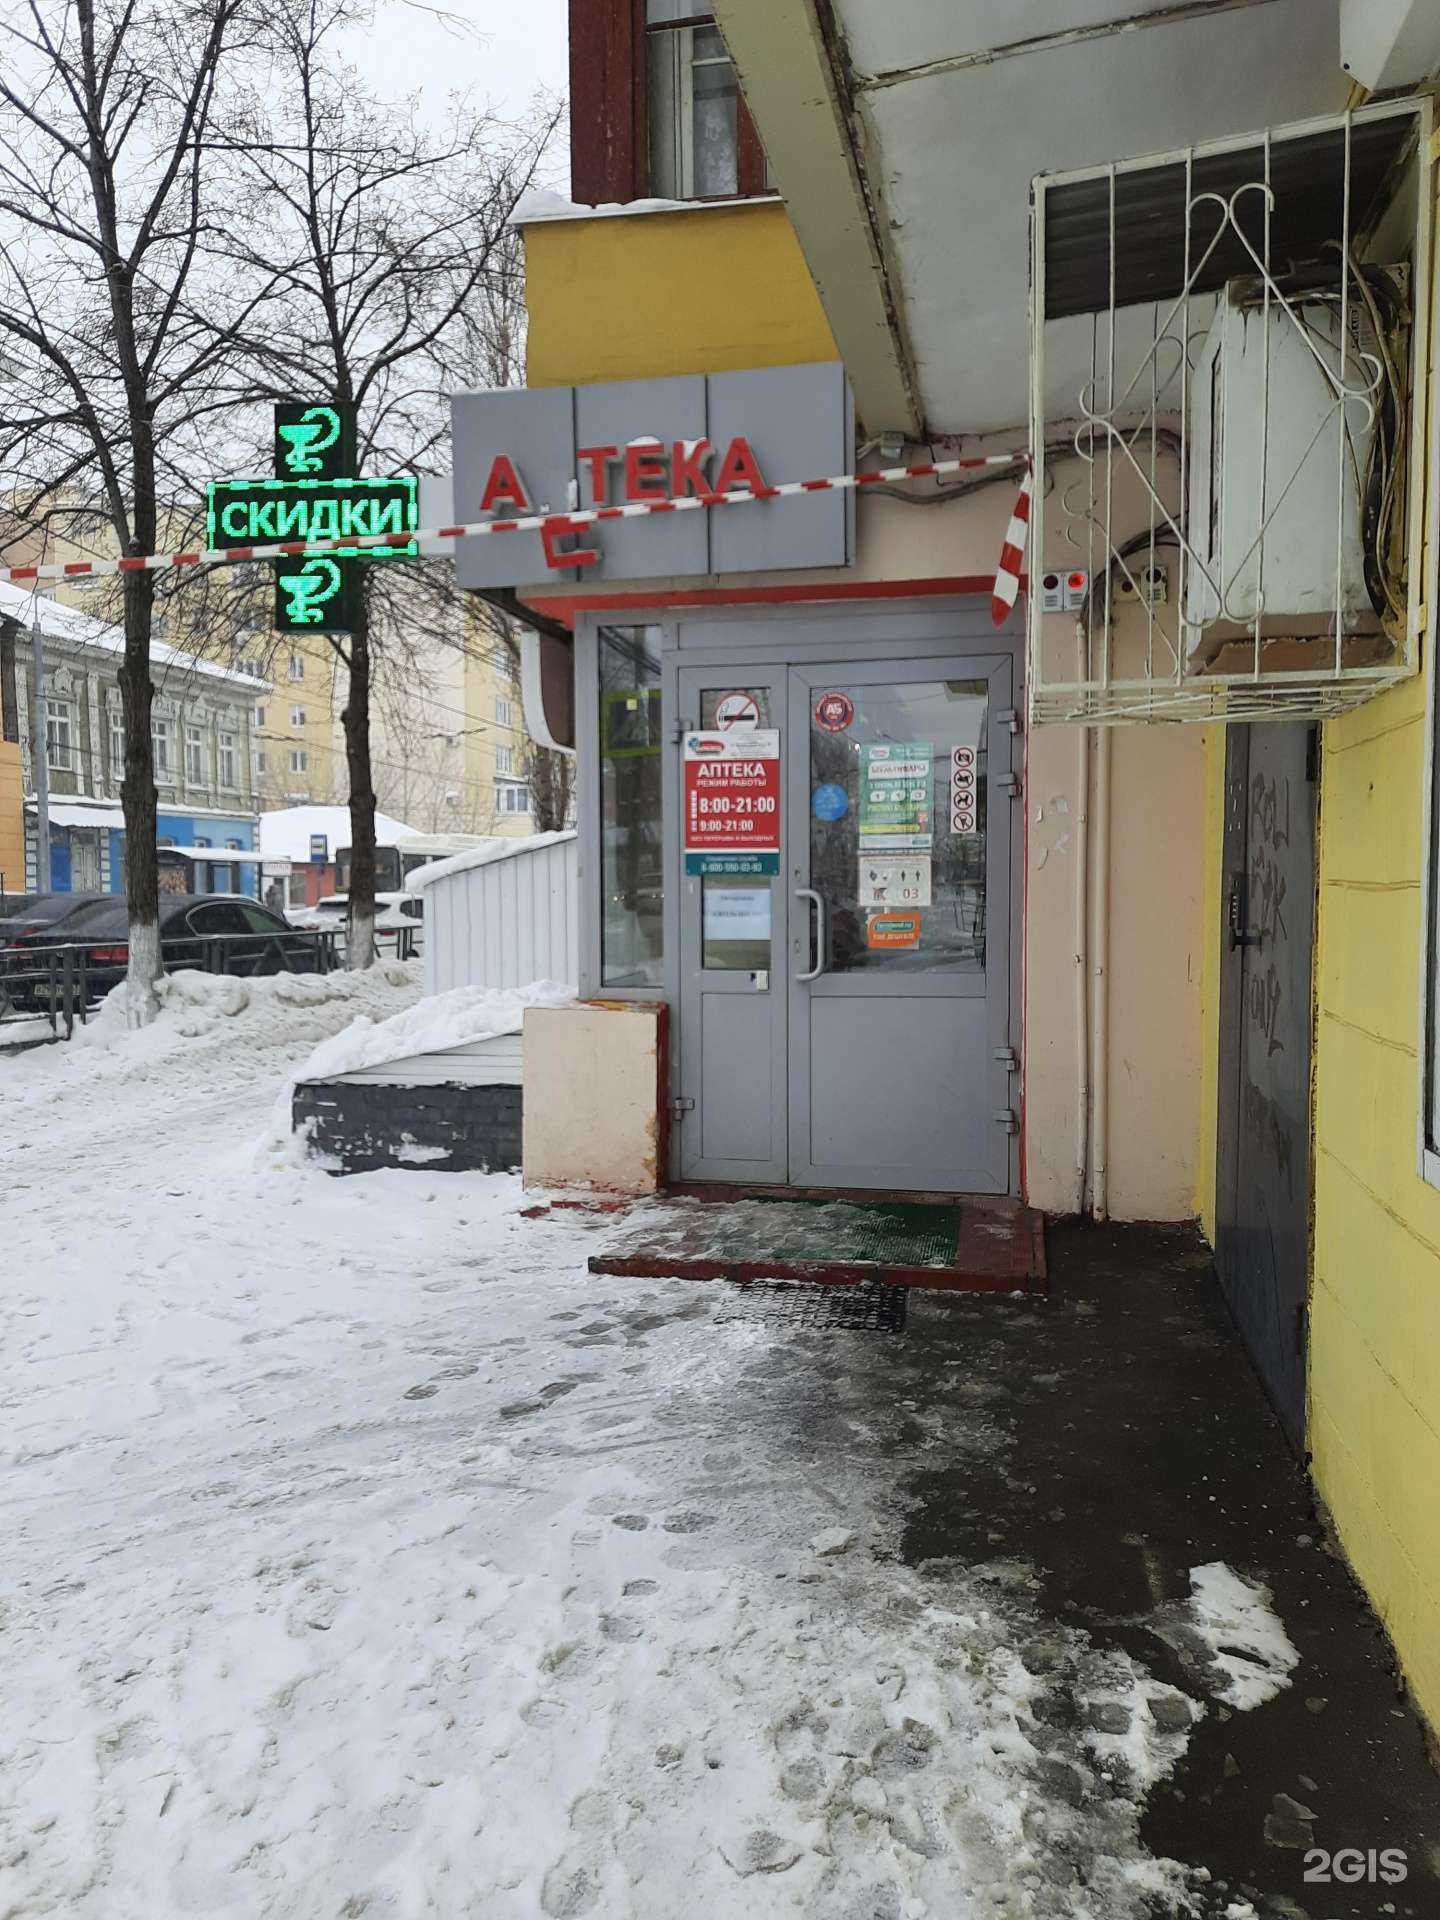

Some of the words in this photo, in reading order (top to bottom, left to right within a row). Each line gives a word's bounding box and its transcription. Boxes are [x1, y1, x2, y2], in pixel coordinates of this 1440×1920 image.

[221, 498, 402, 543] СКИДКИ
[698, 762, 766, 777] АПТЕКА
[697, 779, 728, 787] РЕЖИМ
[731, 778, 767, 786] РАБОТЫ
[700, 796, 775, 813] 8:00-21:00
[700, 820, 754, 832] 9:00-21:00
[903, 888, 919, 899] 03
